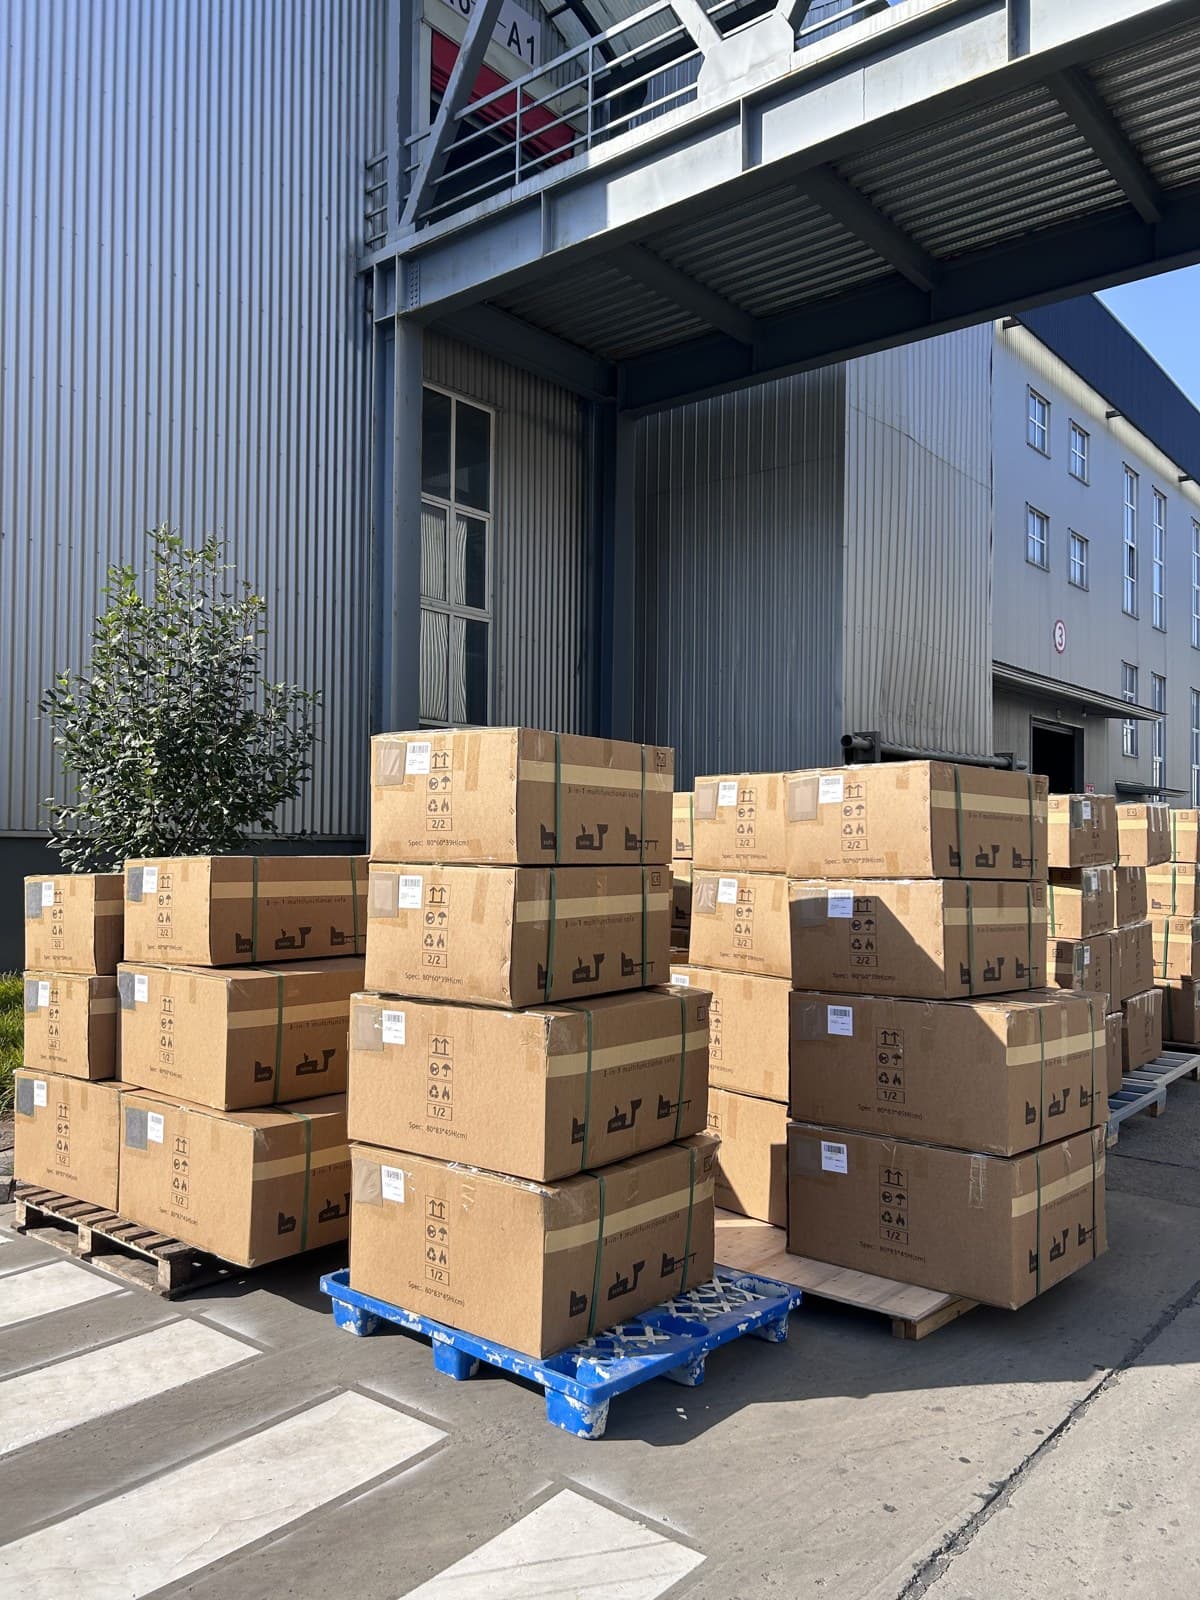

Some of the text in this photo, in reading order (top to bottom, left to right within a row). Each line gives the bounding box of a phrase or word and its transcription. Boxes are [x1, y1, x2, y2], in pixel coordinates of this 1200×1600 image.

[431, 820, 446, 829] 2/2
[739, 839, 750, 847] 2/2
[847, 841, 861, 850] 2/2
[160, 928, 169, 937] 2/2
[737, 939, 748, 947] 2/2
[427, 954, 441, 965] 2/2
[855, 956, 870, 965] 2/2
[883, 1091, 897, 1101] 1/2
[433, 1106, 446, 1117] 1/2
[175, 1195, 184, 1206] 1/2
[886, 1229, 901, 1241] 1/2
[430, 1269, 443, 1281] 1/2
